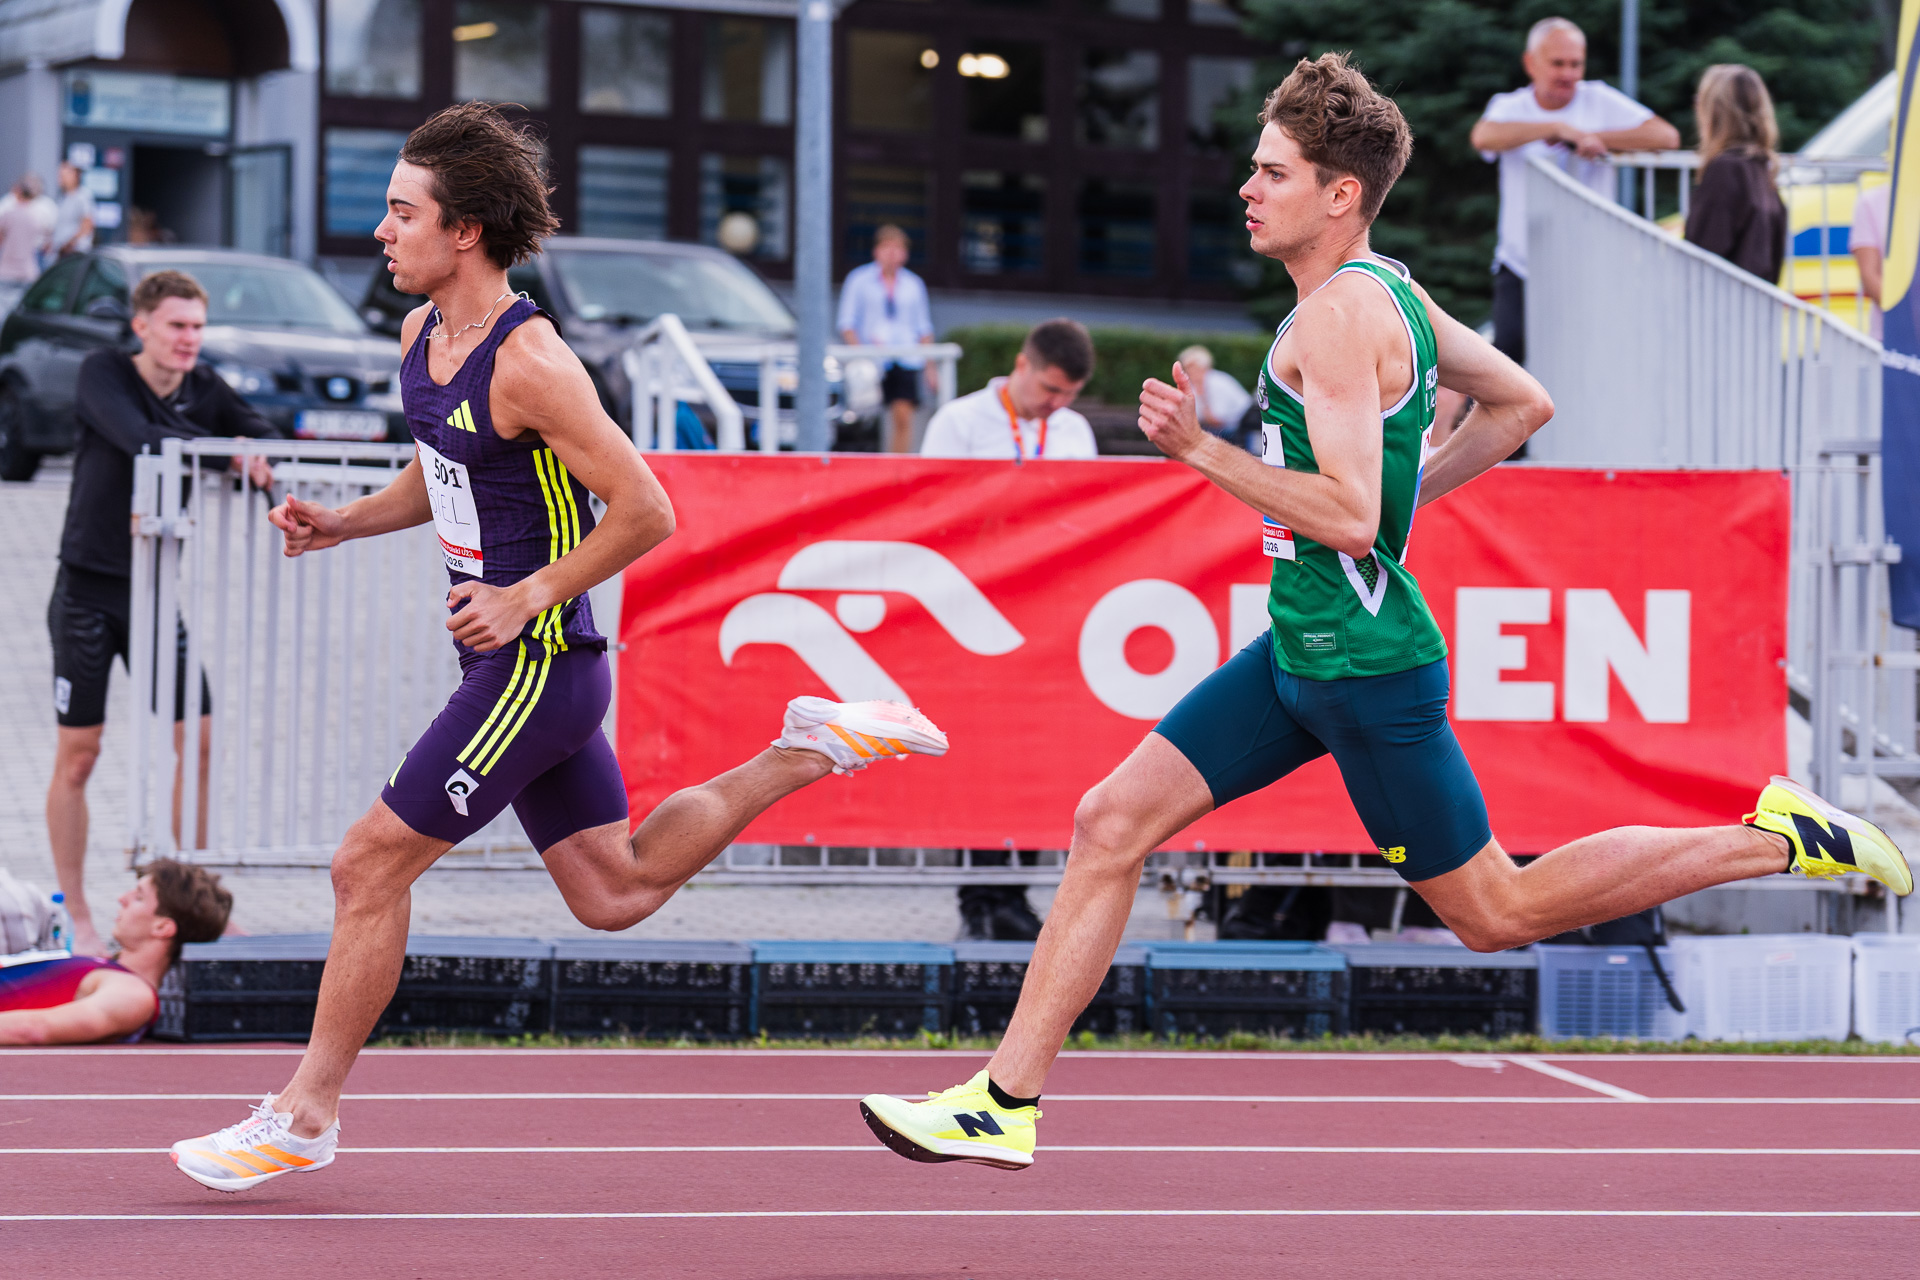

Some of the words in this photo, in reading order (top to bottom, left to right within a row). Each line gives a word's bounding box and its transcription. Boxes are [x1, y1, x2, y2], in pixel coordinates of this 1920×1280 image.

[434, 457, 463, 489] 501
[428, 486, 471, 526] SIEL
[1263, 540, 1279, 553] 2026
[1078, 578, 1691, 723] OEN
